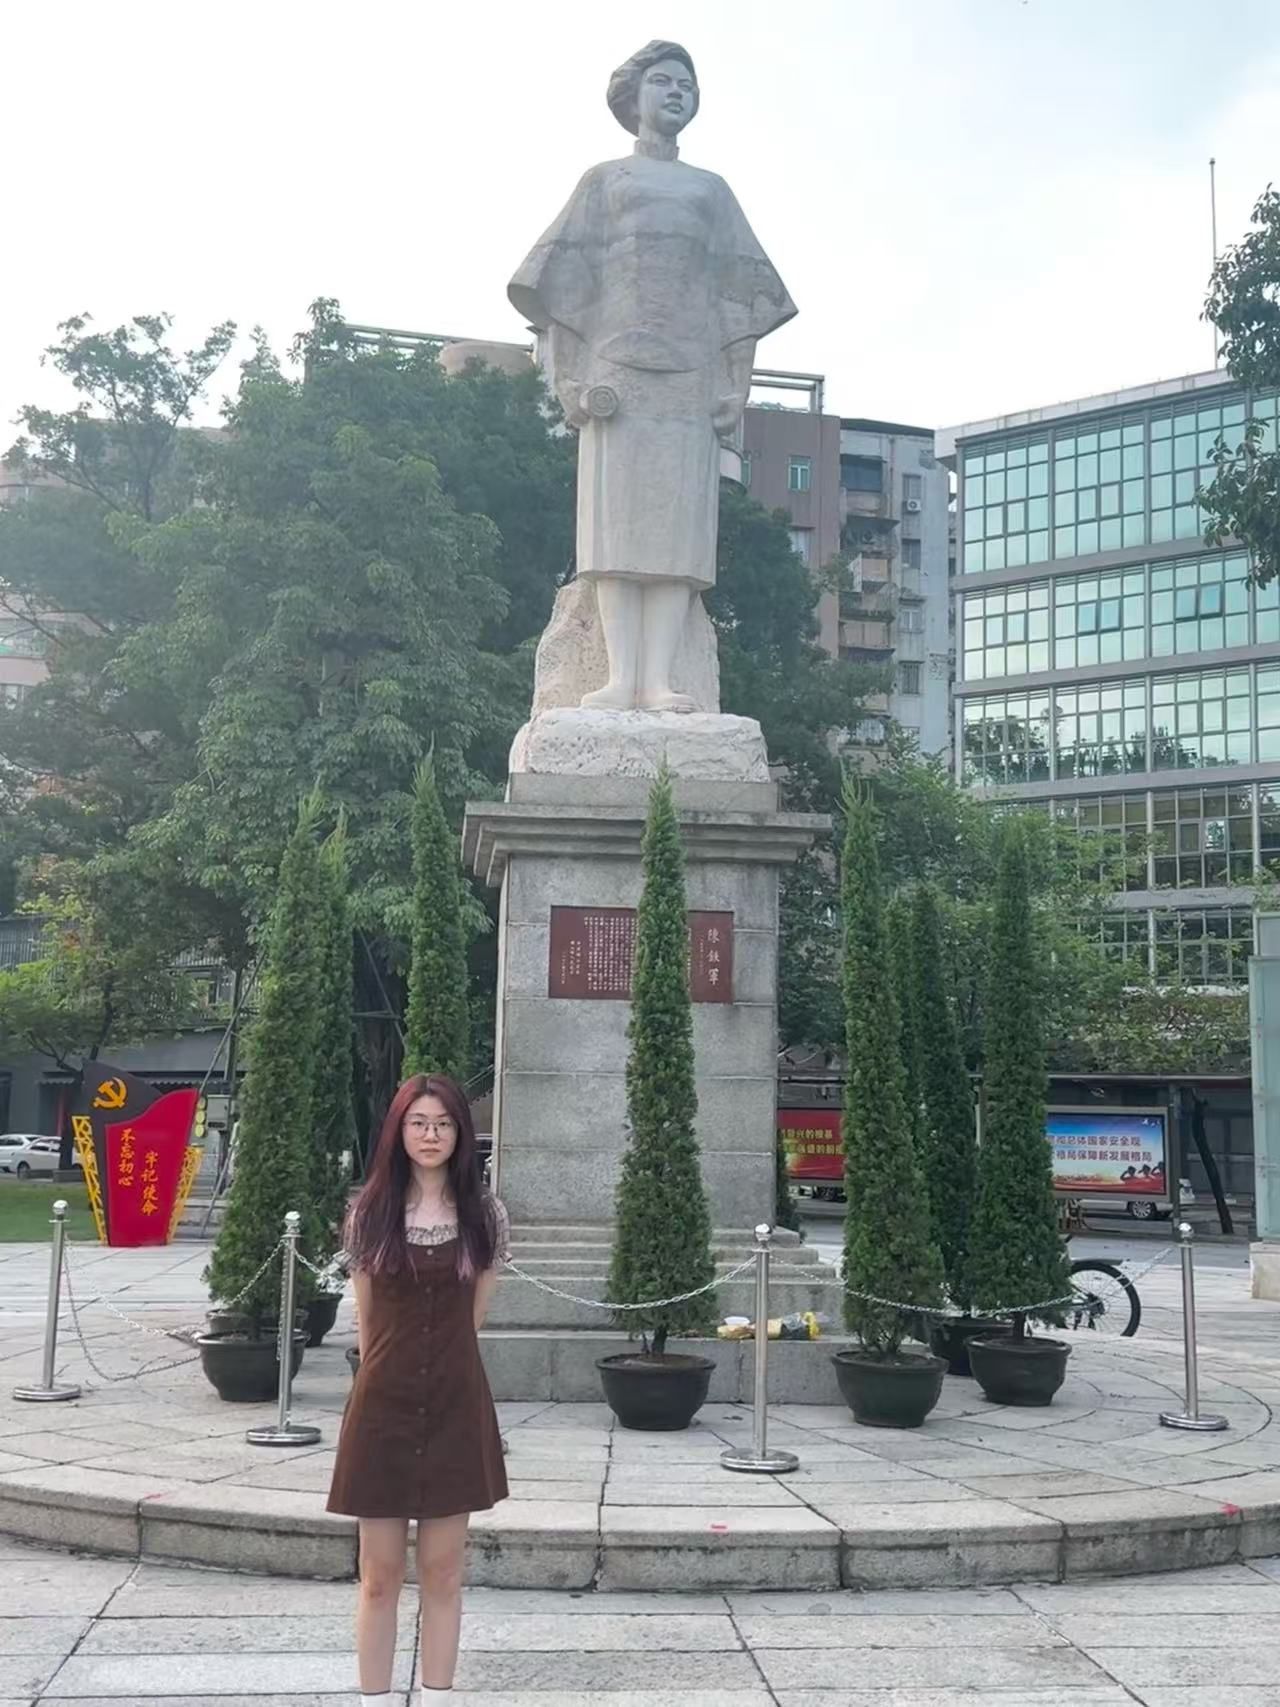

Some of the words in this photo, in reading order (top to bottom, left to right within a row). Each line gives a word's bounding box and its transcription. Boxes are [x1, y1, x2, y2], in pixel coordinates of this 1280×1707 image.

[118, 1128, 135, 1186] 不忘初心
[141, 1151, 158, 1216] 牢记使命
